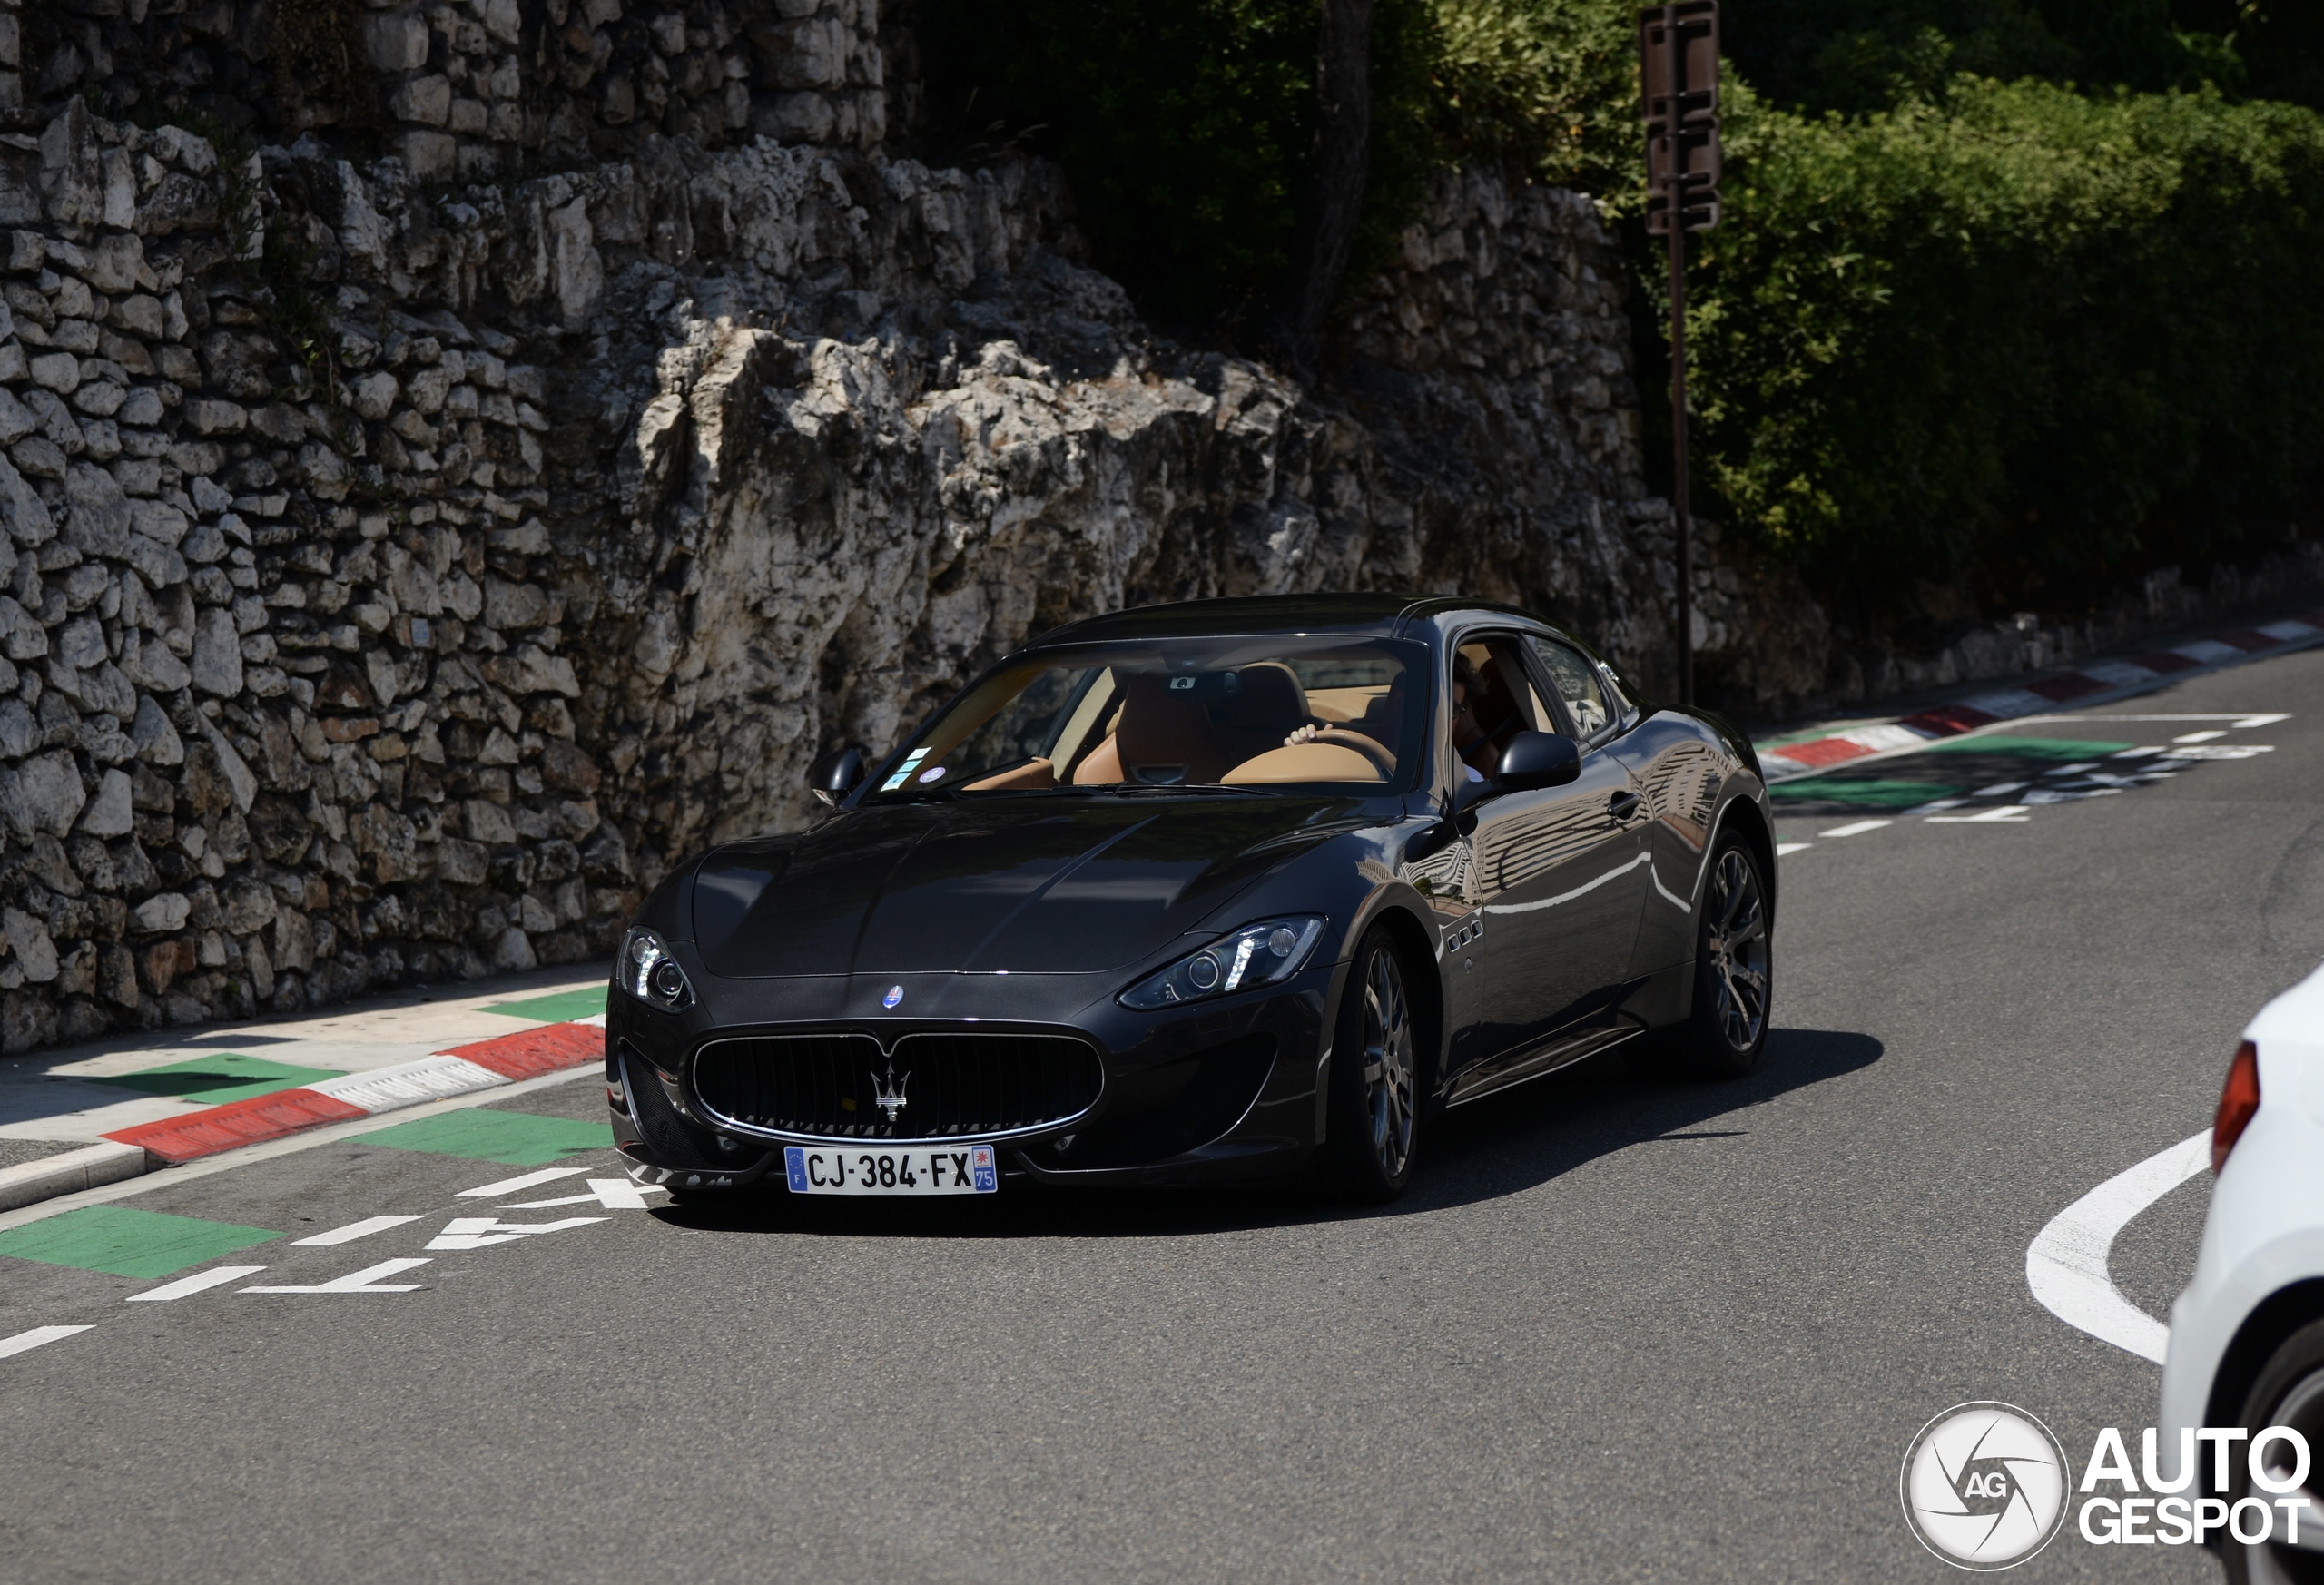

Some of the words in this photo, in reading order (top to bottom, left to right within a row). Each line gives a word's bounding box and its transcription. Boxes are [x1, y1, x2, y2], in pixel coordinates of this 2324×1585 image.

[794, 1174, 800, 1184] F
[808, 1153, 972, 1187] CJ-384-FX
[976, 1171, 993, 1186] 75
